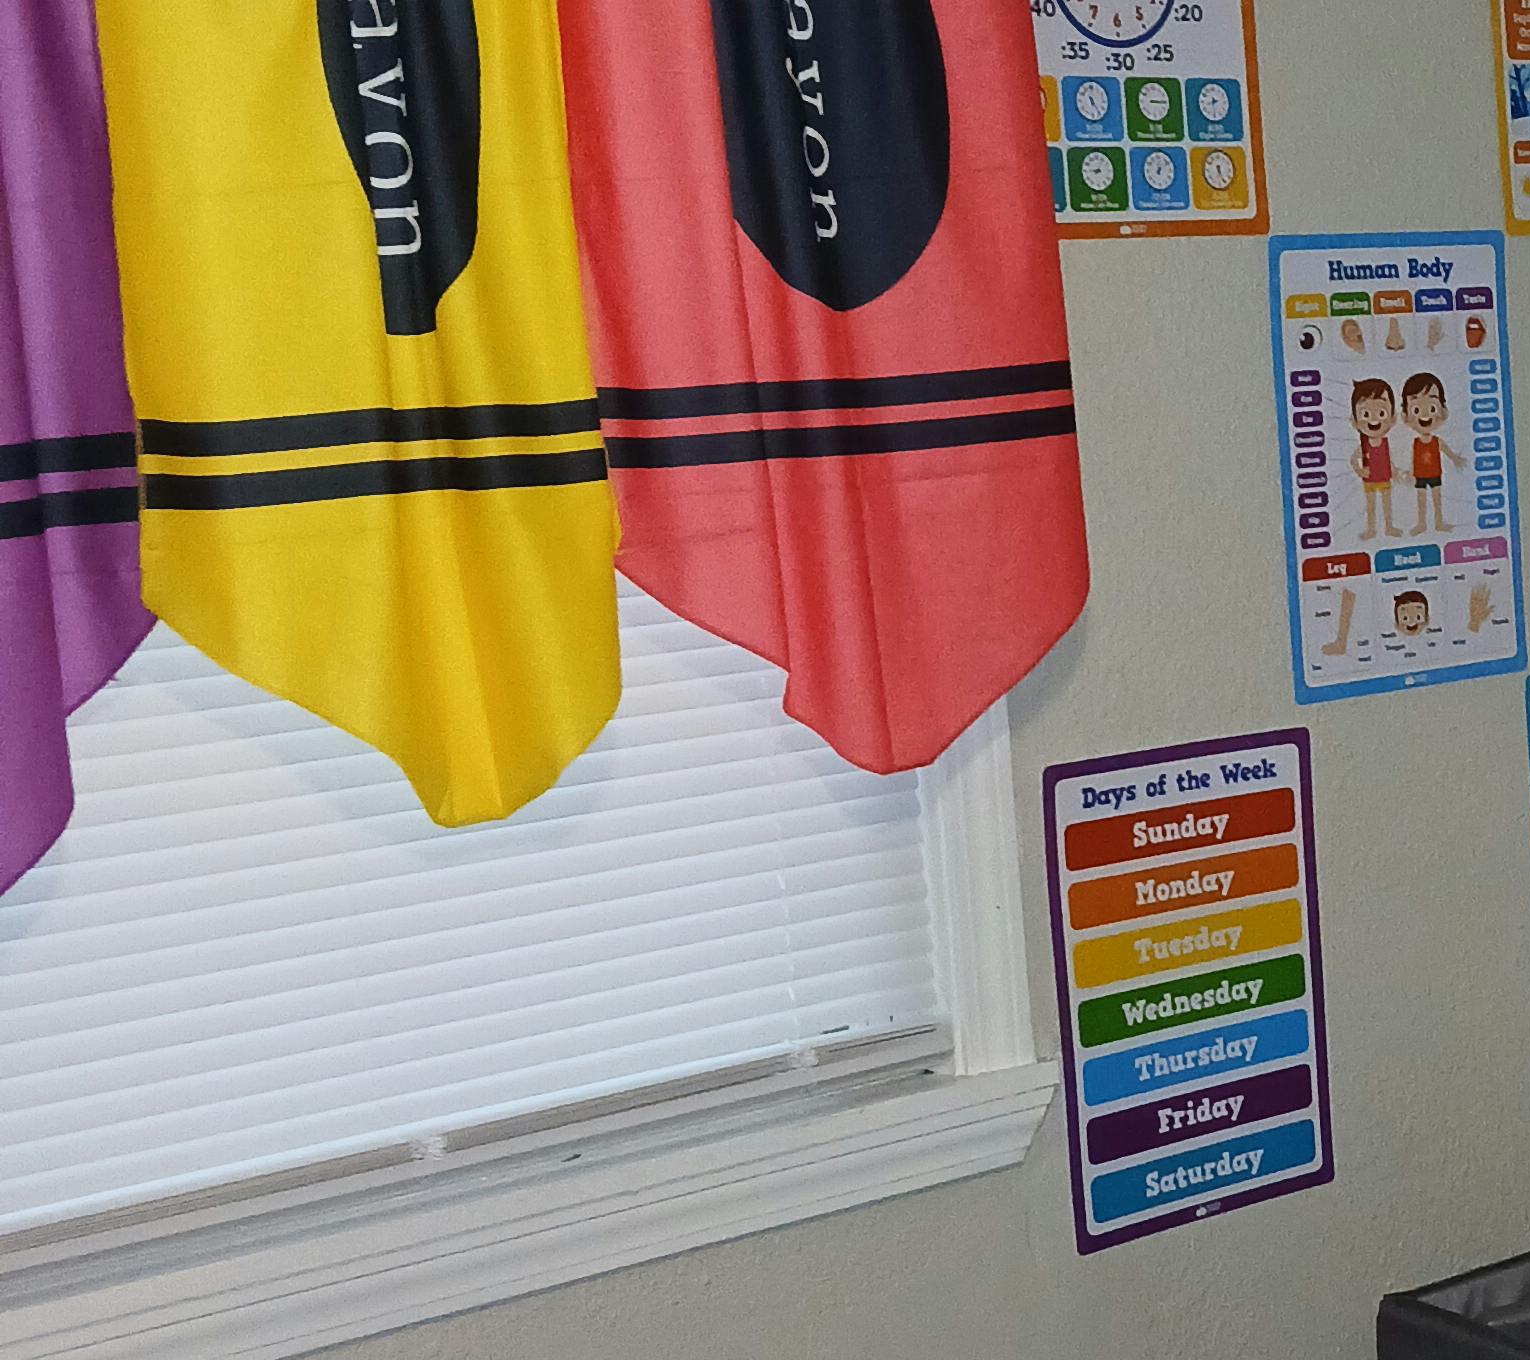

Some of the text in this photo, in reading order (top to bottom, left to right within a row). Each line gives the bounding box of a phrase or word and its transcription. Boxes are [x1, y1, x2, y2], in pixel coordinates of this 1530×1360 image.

[1089, 4, 1099, 20] 7
[1112, 12, 1122, 28] 6
[1135, 5, 1144, 21] 5
[1174, 4, 1203, 22] :20
[1060, 42, 1091, 61] :35
[1105, 52, 1135, 71] :30
[1146, 43, 1175, 62] :25
[1328, 256, 1454, 284] Human Body
[1327, 562, 1347, 575] Leg
[1394, 552, 1422, 566] Head
[1081, 758, 1278, 810] Days of the Week
[1132, 813, 1230, 848] Sunday
[1134, 870, 1236, 907] Monday
[1133, 924, 1244, 965] Tuesday
[1121, 978, 1264, 1026] Wednesday
[1134, 1035, 1259, 1082] Thursday
[1157, 1094, 1245, 1134] Friday
[1145, 1148, 1265, 1199] Saturday
